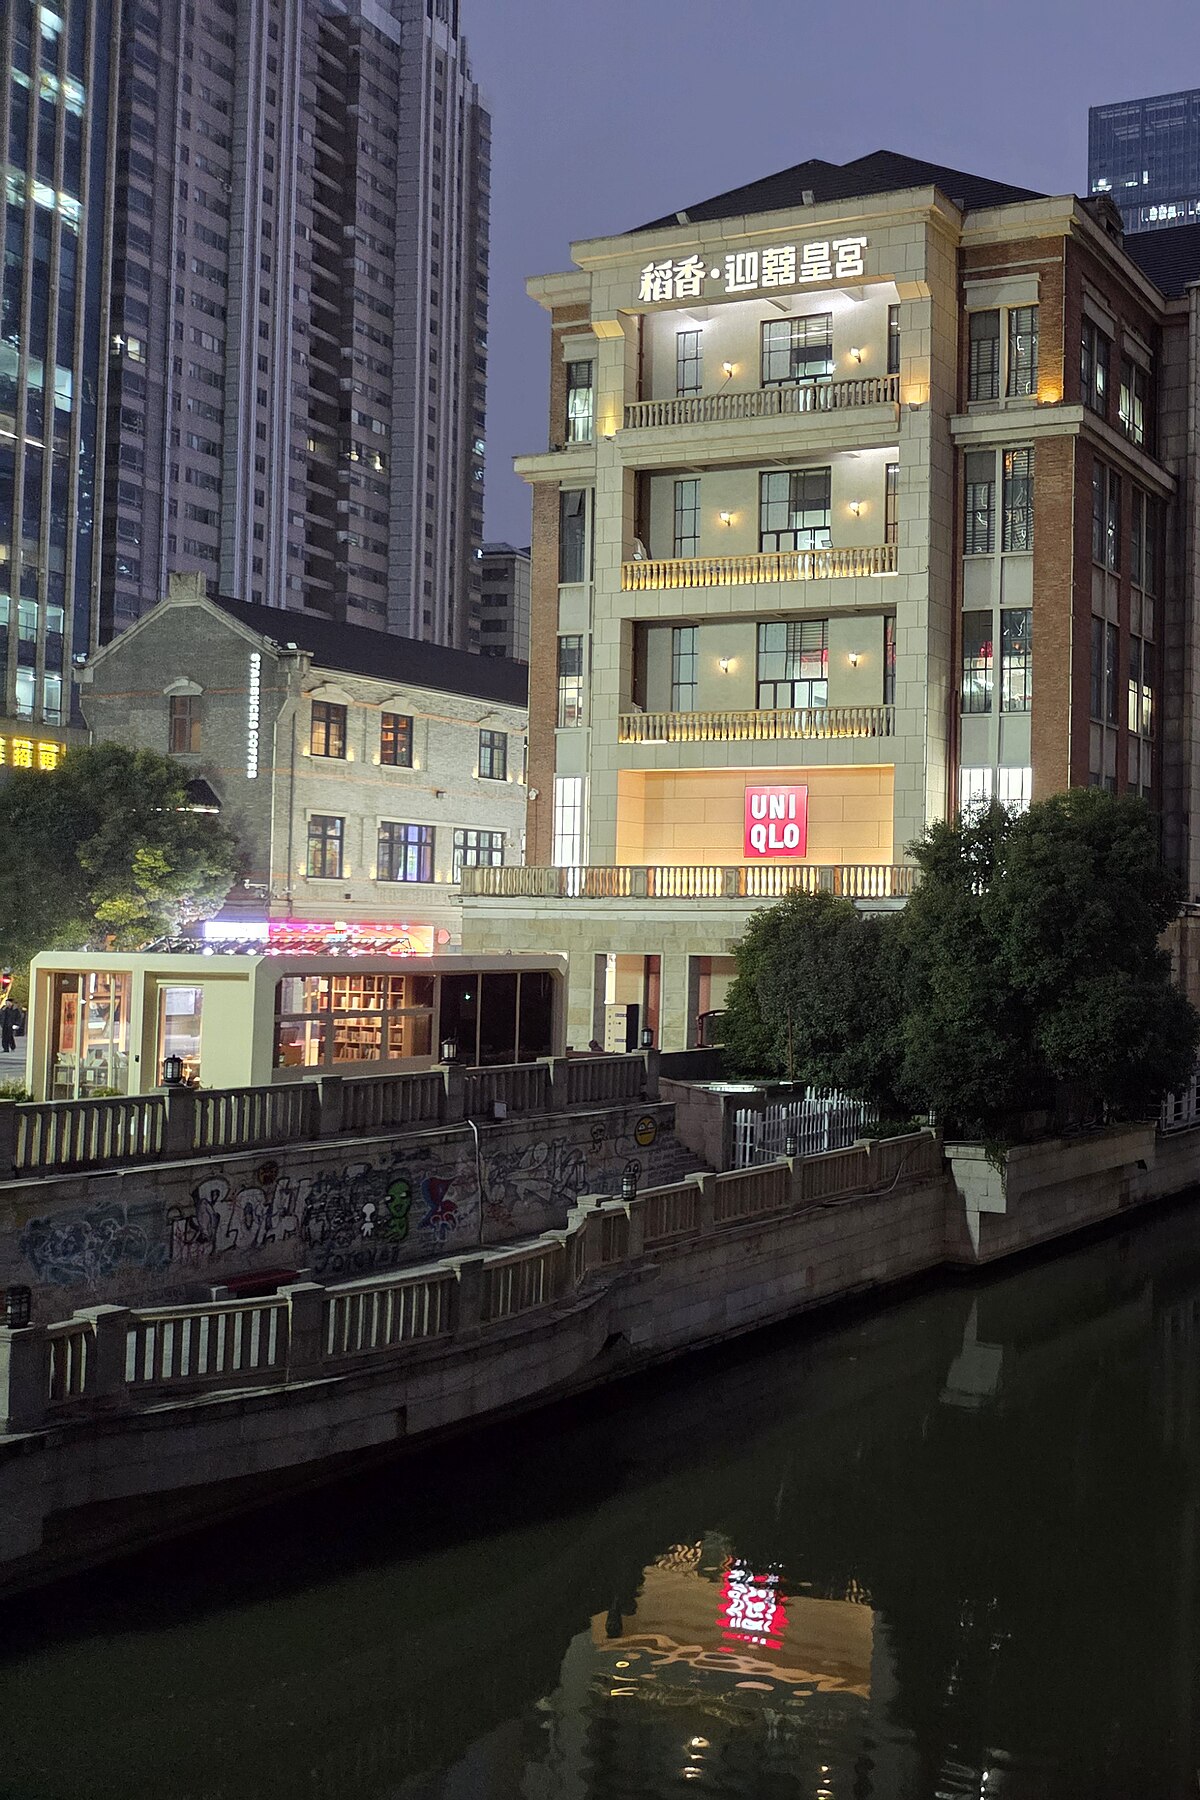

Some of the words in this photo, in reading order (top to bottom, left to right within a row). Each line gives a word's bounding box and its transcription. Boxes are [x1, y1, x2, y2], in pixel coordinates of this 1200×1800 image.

[249, 653, 261, 729] STARBUCKS
[247, 730, 258, 779] COFFEE
[751, 794, 796, 819] UNI
[750, 823, 800, 853] QLO
